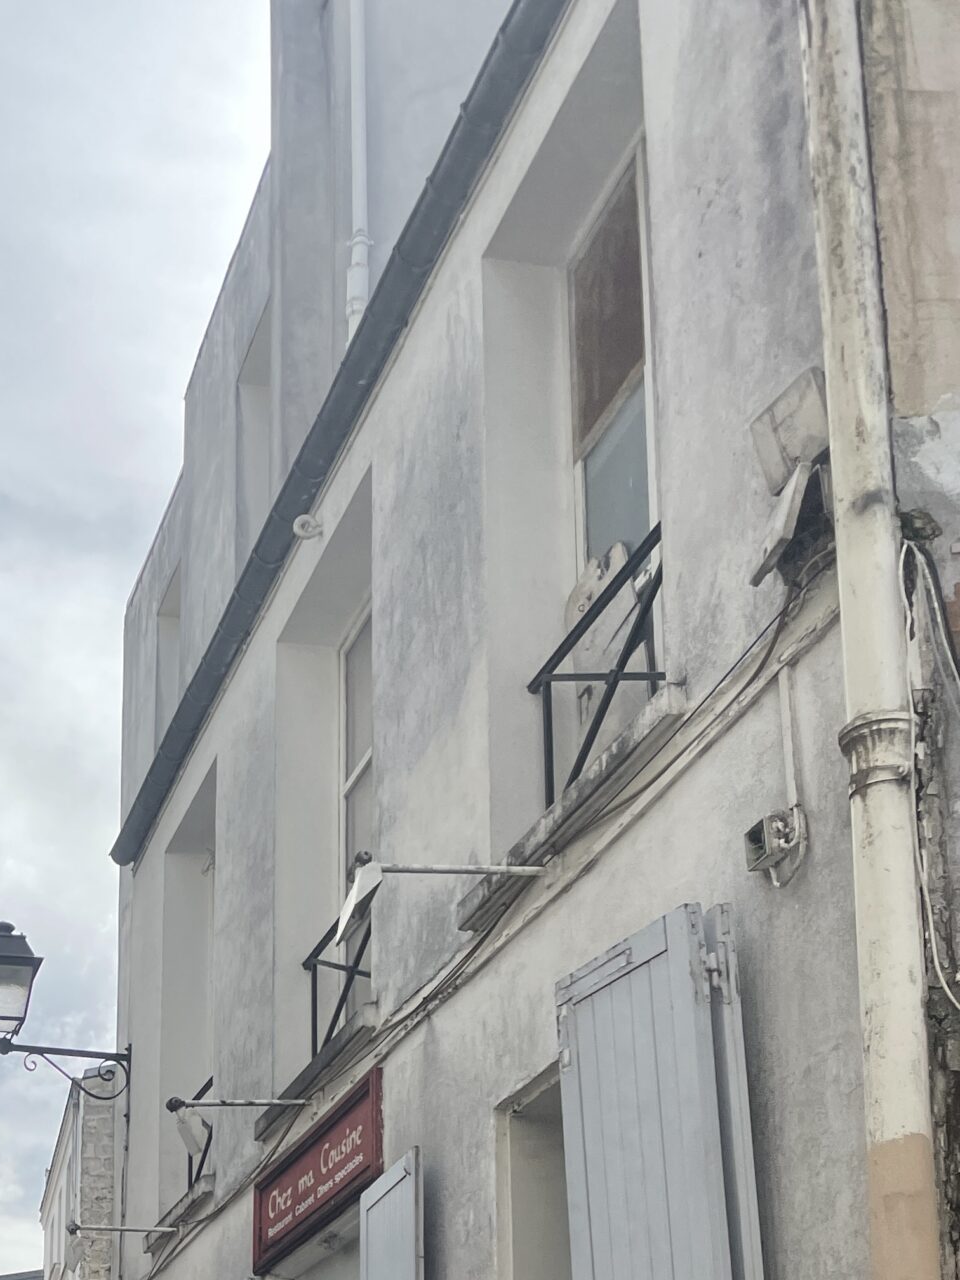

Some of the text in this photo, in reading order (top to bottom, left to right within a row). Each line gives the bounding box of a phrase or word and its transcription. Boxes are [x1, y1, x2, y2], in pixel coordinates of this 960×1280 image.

[268, 1124, 363, 1219] Chez ma Cousine
[295, 1193, 315, 1216] Cabaret
